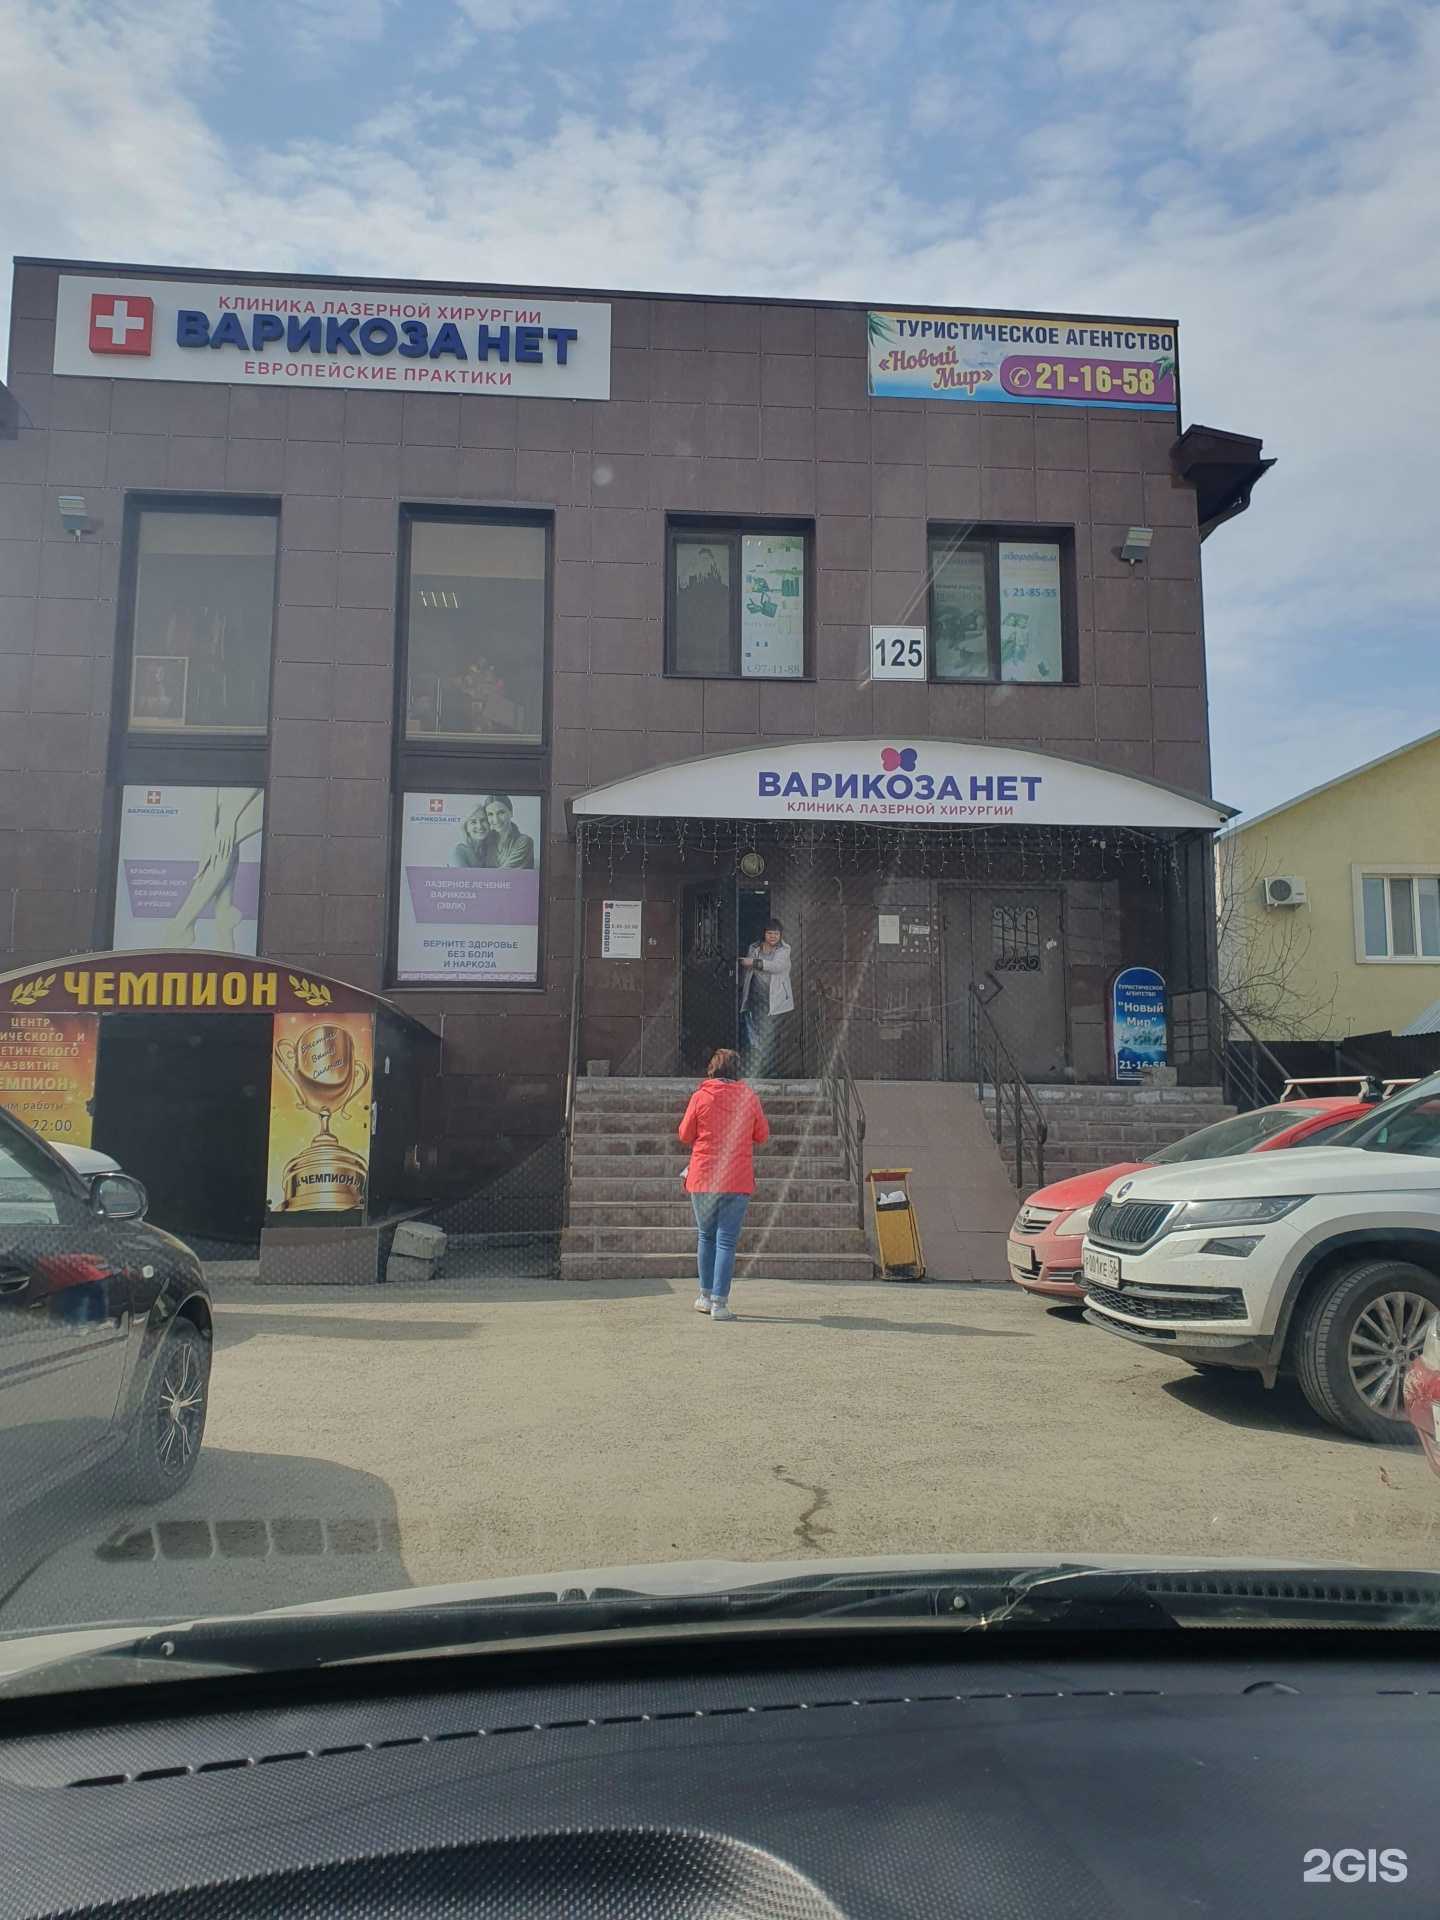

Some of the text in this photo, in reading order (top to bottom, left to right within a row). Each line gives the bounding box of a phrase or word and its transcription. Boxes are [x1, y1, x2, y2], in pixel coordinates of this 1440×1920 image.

[219, 296, 541, 324] КЛИНИКА ЛАЗЕРНОЙ ХИРУРГИИ
[176, 309, 578, 365] ВАРИКОЗА НЕТ
[896, 319, 1173, 352] ТУРИСТИЧЕСКОЕ АГЕНТСТВО
[878, 346, 959, 372] «Новый
[244, 361, 512, 385] ЕВРОПЕЙСКИЕ ПРАКТИКИ
[932, 367, 994, 396] Мир»
[1035, 362, 1156, 396] 21-16-58
[875, 639, 923, 668] 125
[758, 771, 1043, 802] ВАРИКОЗА НЕТ
[787, 802, 1014, 817] КЛИНИКА ЛАЗЕРНОЙ ХИРУРГИИ
[425, 880, 512, 890] ЛАЗЕРНОЕ ЛЕЧЕНИЕ
[430, 891, 477, 899] ВАРИКОЗА
[423, 939, 519, 950] ВЕРНИТЕ ЗДОРОВЬЕ
[447, 951, 494, 959] БЕЗ БОЛИ
[443, 960, 497, 969] И НАРКОЗА
[63, 971, 278, 1006] ЧЕМПИОН
[11, 1016, 50, 1028] ЦЕНТР
[77, 1032, 85, 1041] И
[33, 1119, 73, 1132] 22:00
